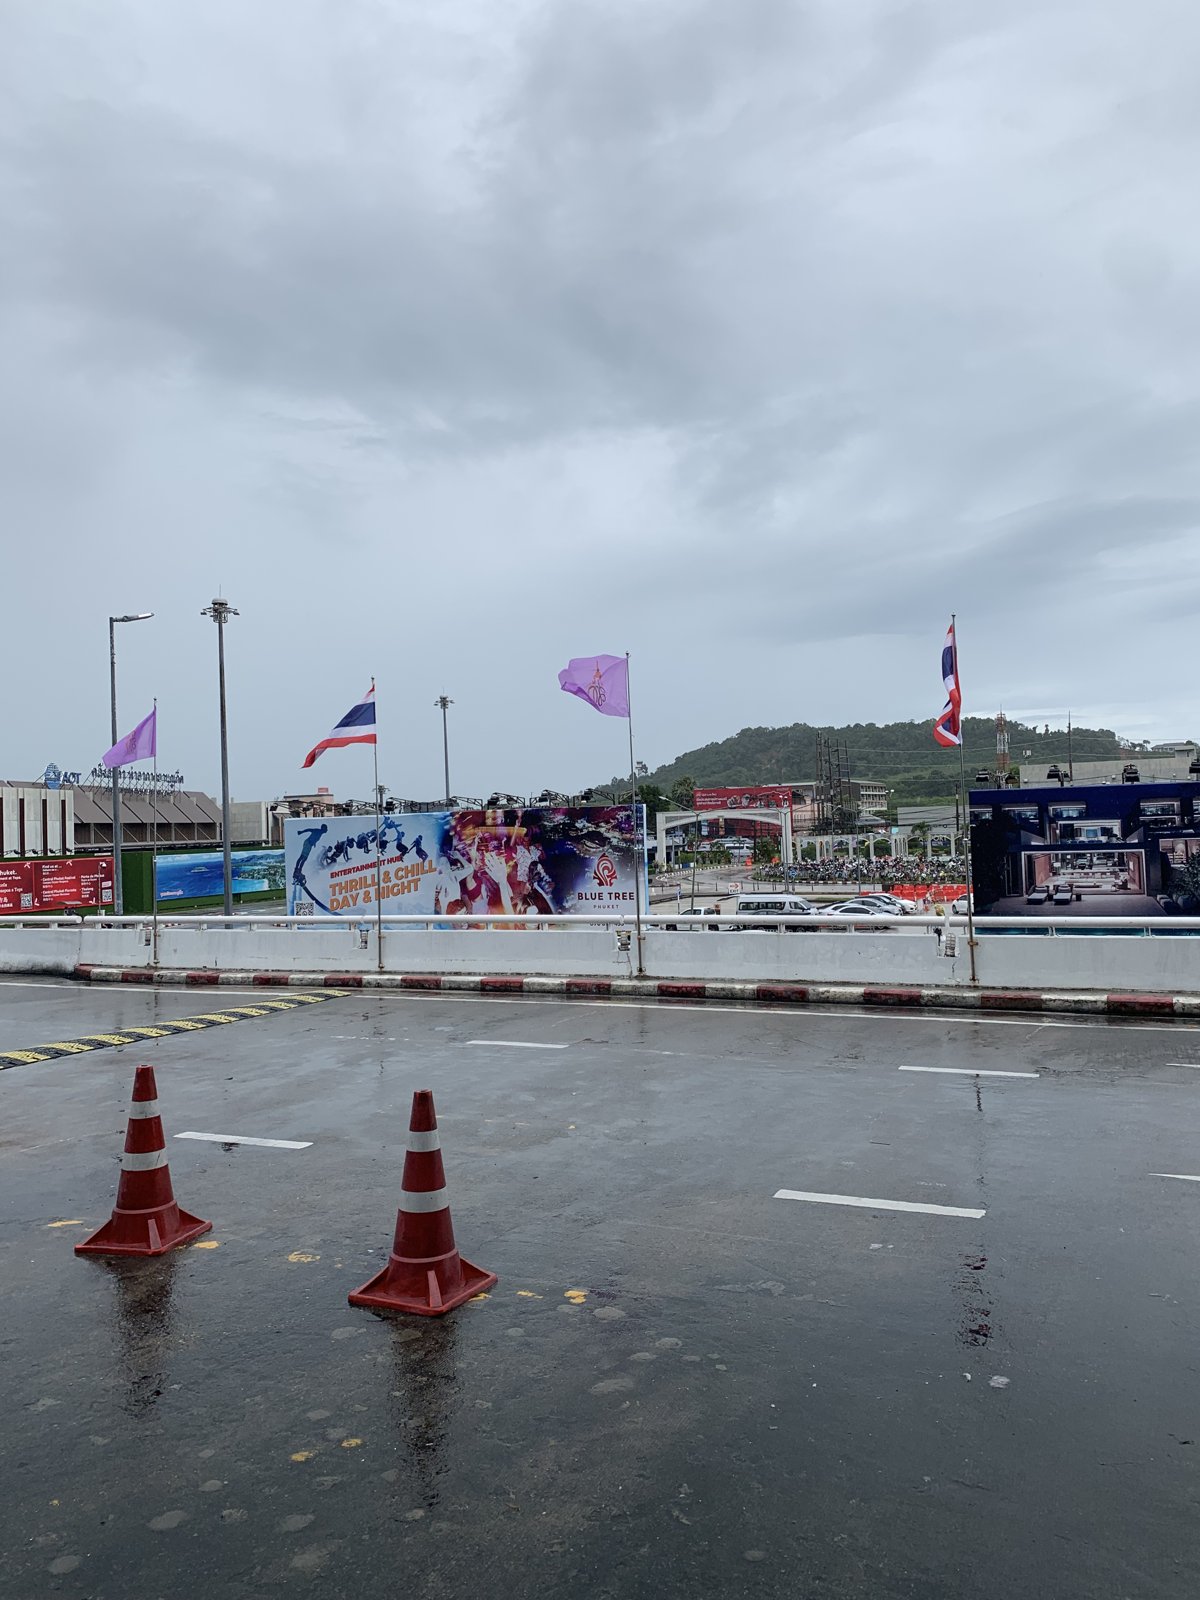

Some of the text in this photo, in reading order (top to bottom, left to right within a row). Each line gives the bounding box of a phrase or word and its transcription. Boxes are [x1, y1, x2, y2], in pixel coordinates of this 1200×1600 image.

[62, 772, 82, 784] AOT
[386, 855, 402, 865] HUB
[329, 859, 437, 896] THRILL & CHILL
[330, 877, 421, 911] DAY & NIGHT
[577, 892, 635, 901] BLUE TREE
